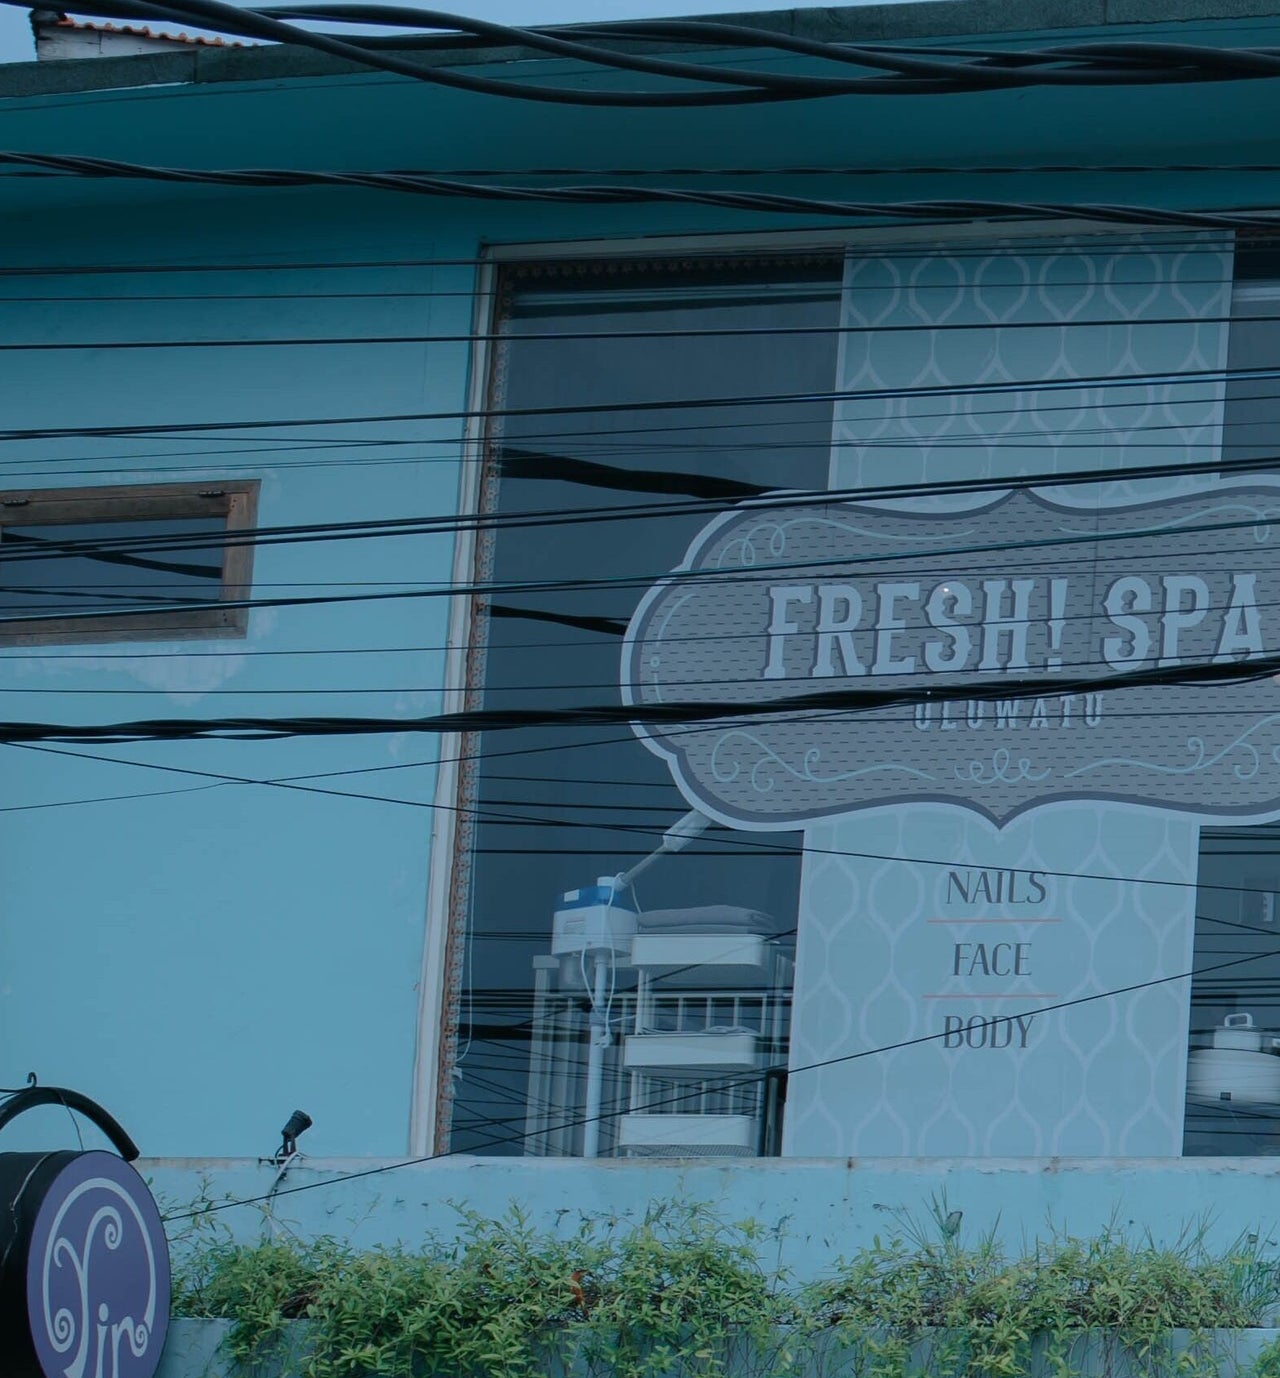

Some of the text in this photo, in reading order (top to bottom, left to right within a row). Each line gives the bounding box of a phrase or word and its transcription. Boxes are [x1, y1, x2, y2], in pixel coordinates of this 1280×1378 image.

[760, 574, 1266, 678] FRESH! SPA
[947, 871, 1047, 904] NAILS
[952, 943, 1032, 976] FACE
[942, 1015, 1035, 1049] BODY
